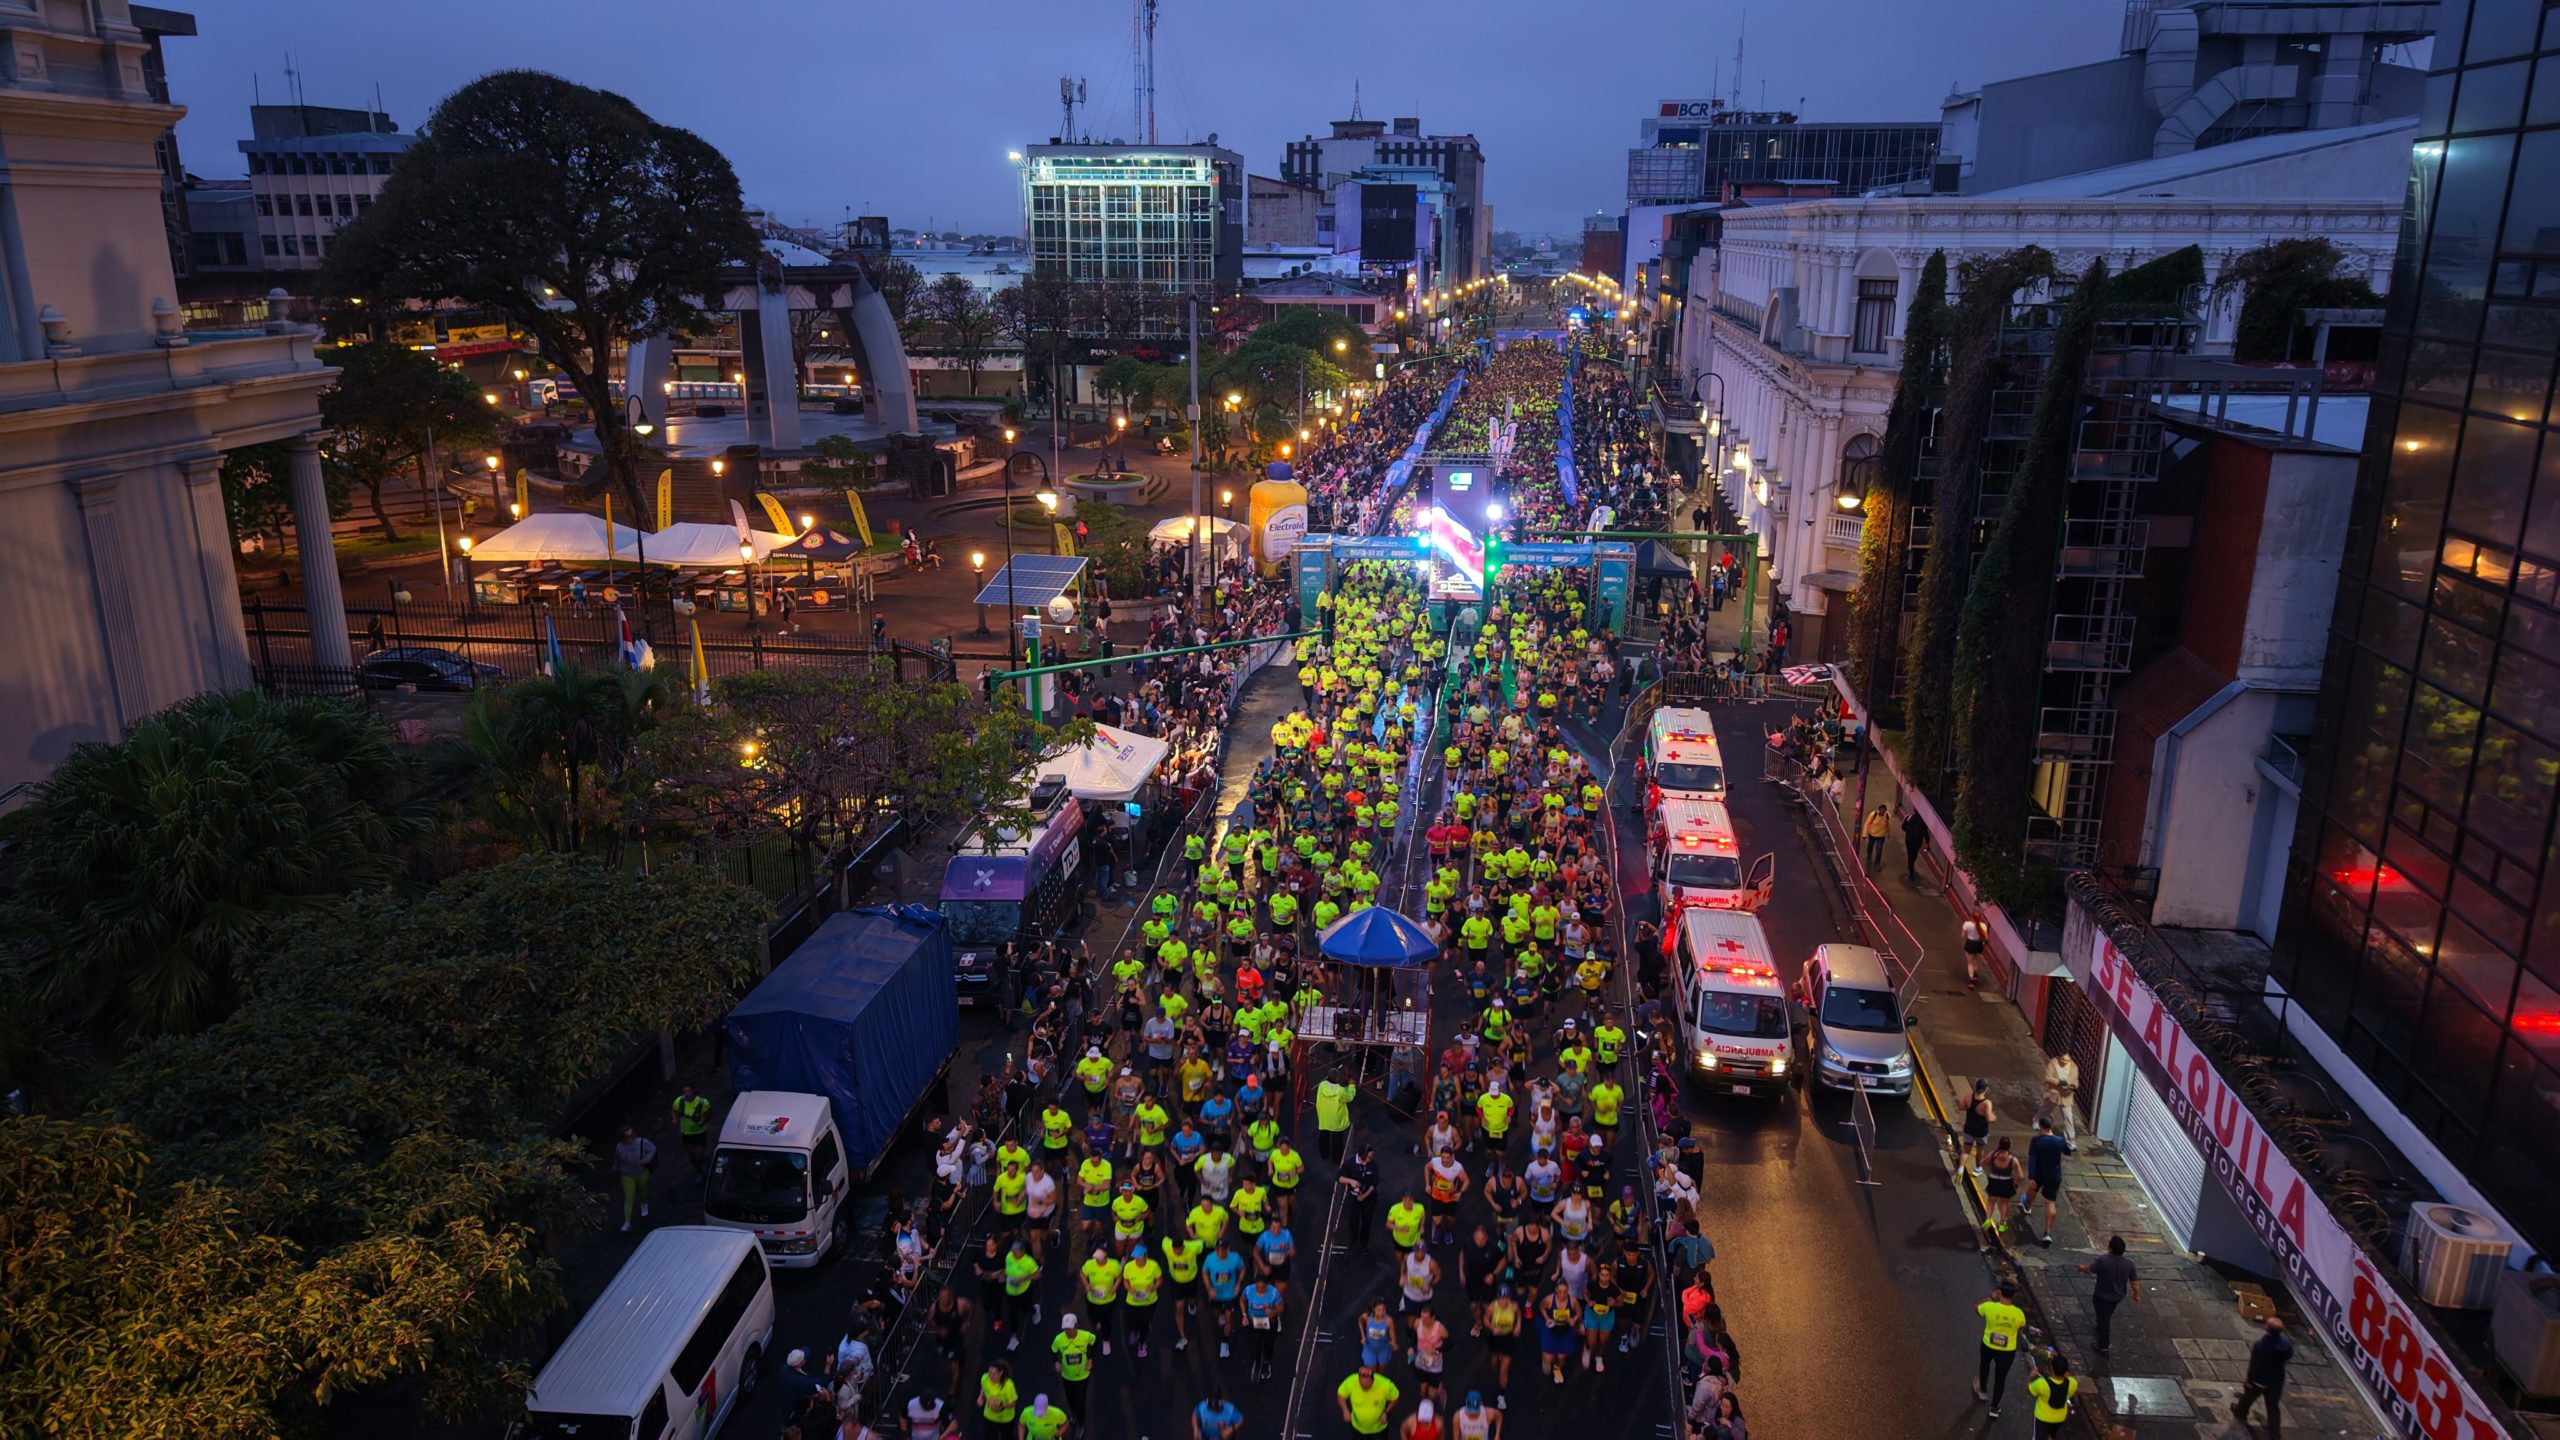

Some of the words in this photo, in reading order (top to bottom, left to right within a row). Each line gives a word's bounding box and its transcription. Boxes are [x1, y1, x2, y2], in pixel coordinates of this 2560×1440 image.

[1678, 103, 1709, 117] BCR
[1269, 522, 1305, 532] Electrolit
[2099, 939, 2135, 1018] SE
[2143, 1000, 2305, 1253] ALQUILA
